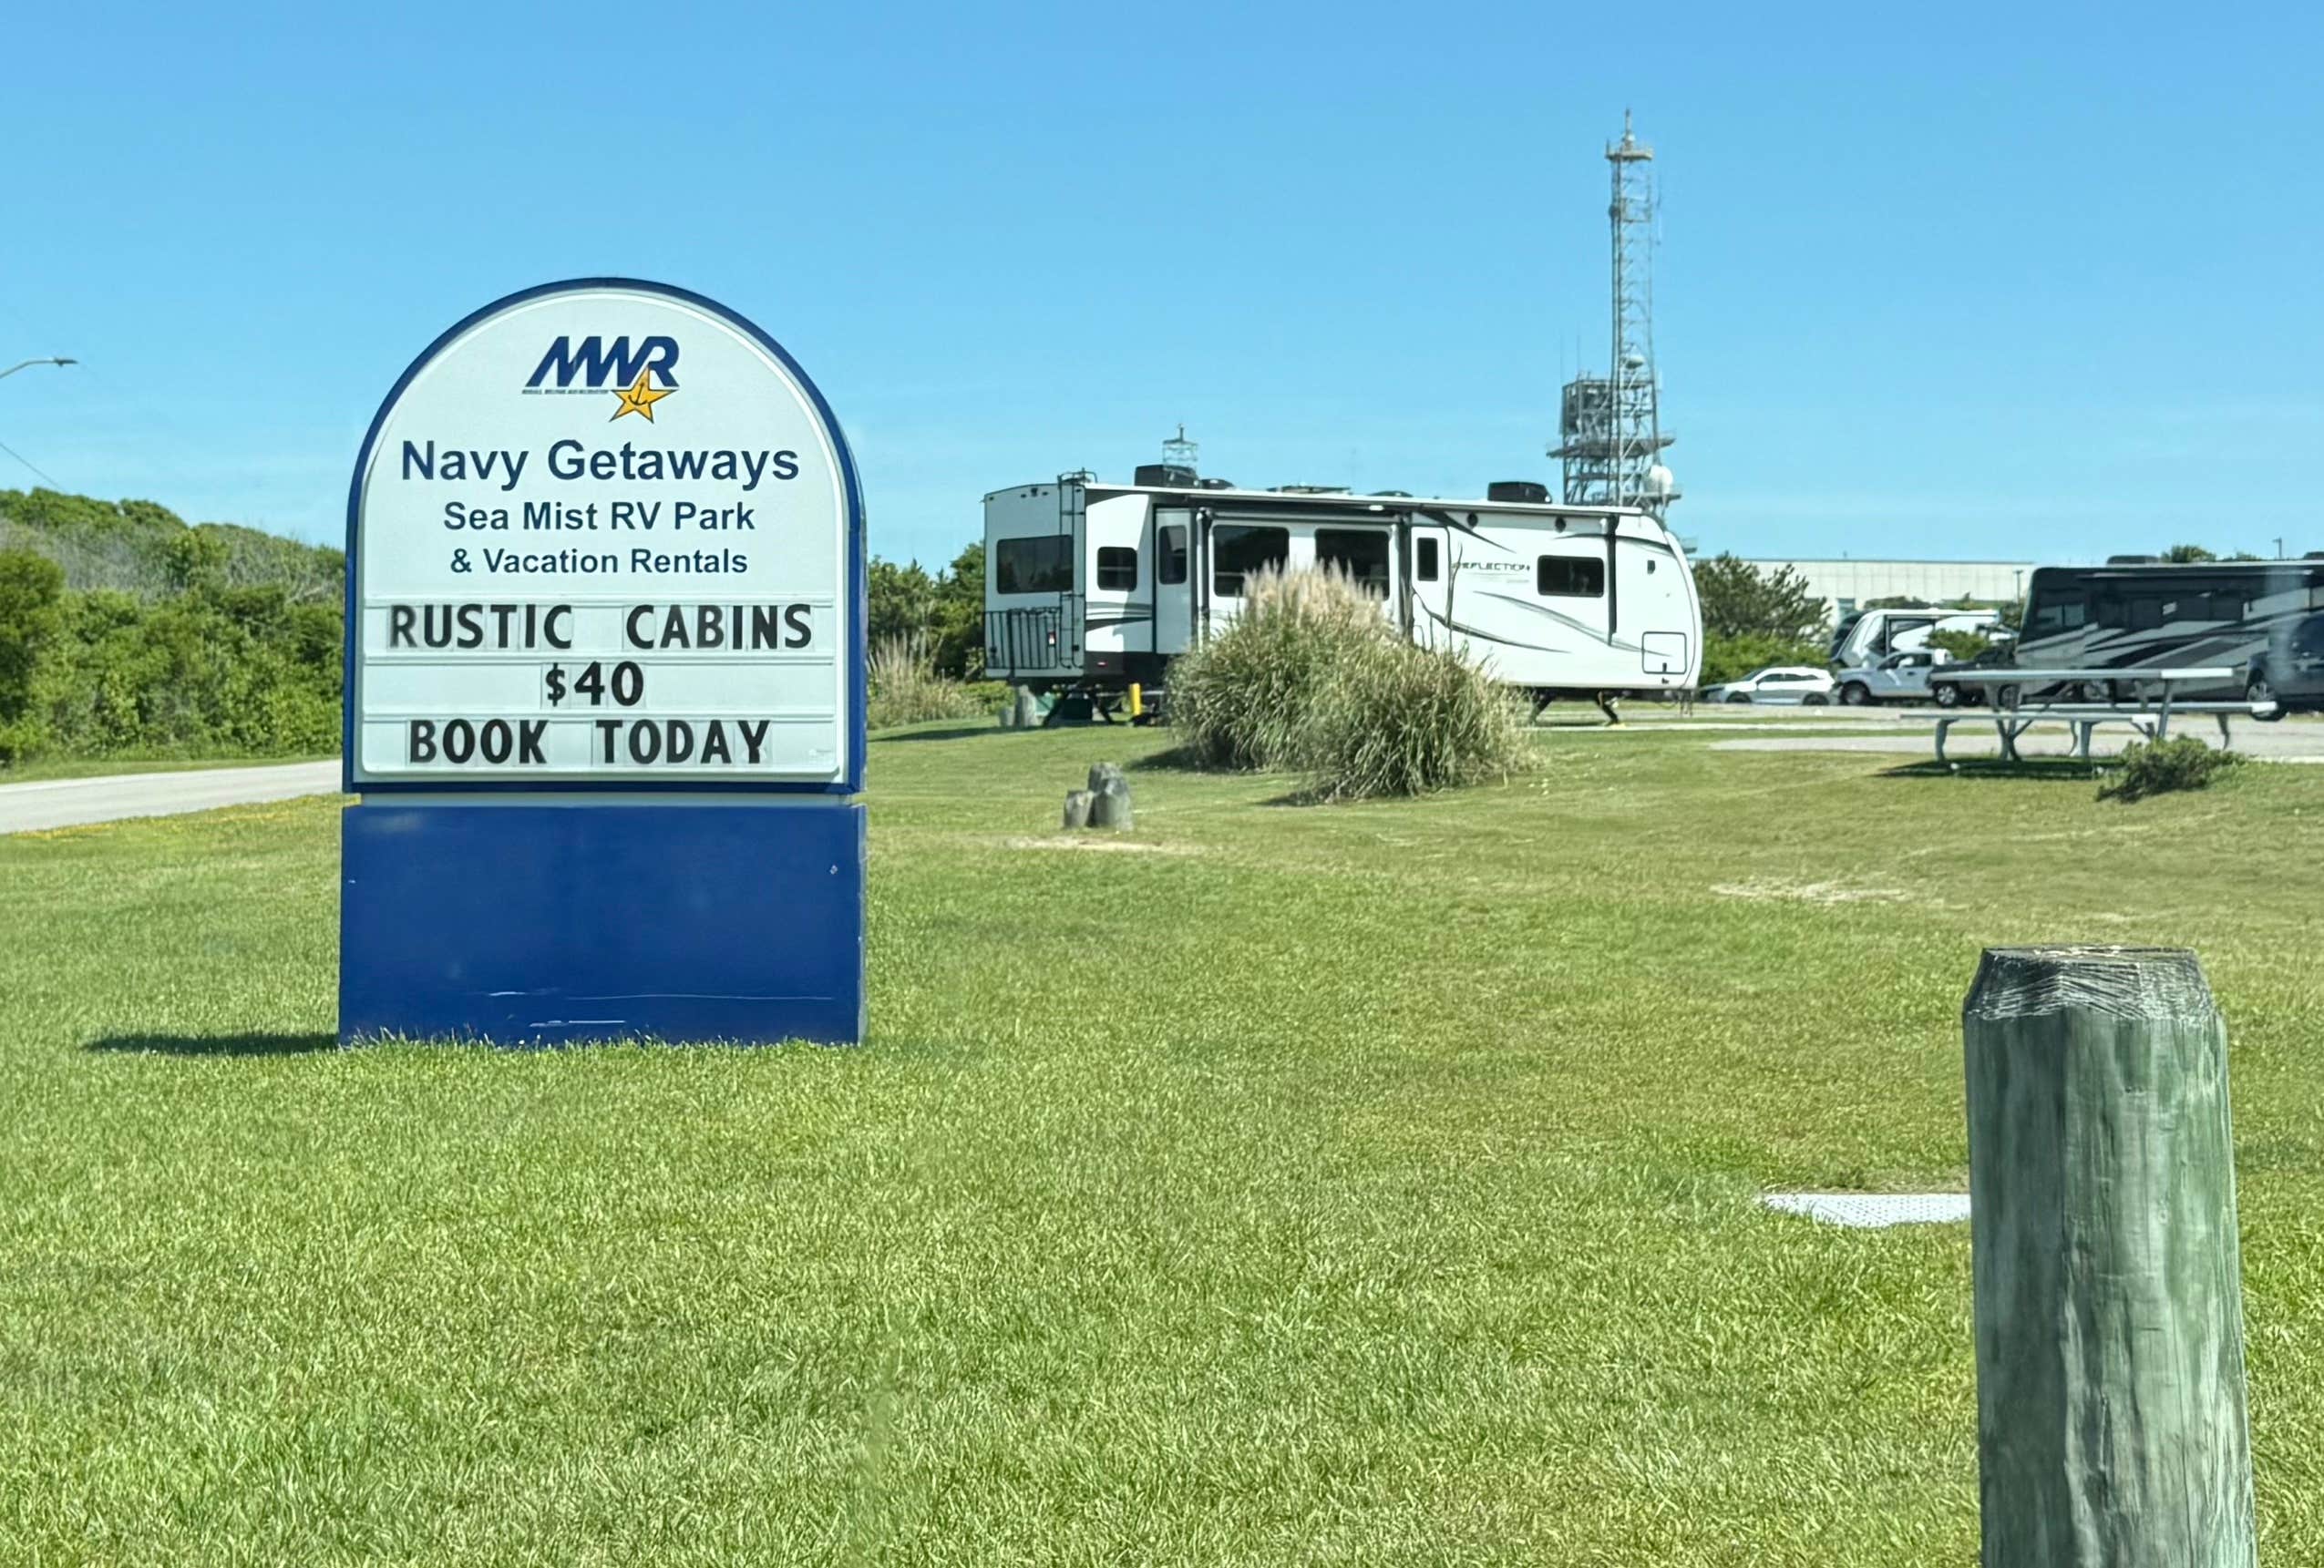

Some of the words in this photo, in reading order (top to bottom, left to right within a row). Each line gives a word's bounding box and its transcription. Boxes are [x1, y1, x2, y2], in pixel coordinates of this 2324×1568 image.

[524, 335, 680, 388] MWR
[402, 441, 530, 491] Navy
[548, 440, 799, 491] Getaways
[444, 502, 509, 530] Sea
[523, 502, 598, 530] Mist
[611, 502, 662, 530] RV
[674, 502, 756, 530] Park
[450, 548, 472, 573] &
[483, 548, 618, 573] Vacation
[631, 548, 748, 573] Rentals
[389, 604, 572, 650] RUSTIC
[626, 604, 812, 650] CABINS
[546, 661, 644, 707] $40
[409, 719, 548, 764] BOOK
[596, 719, 771, 764] TODAY
